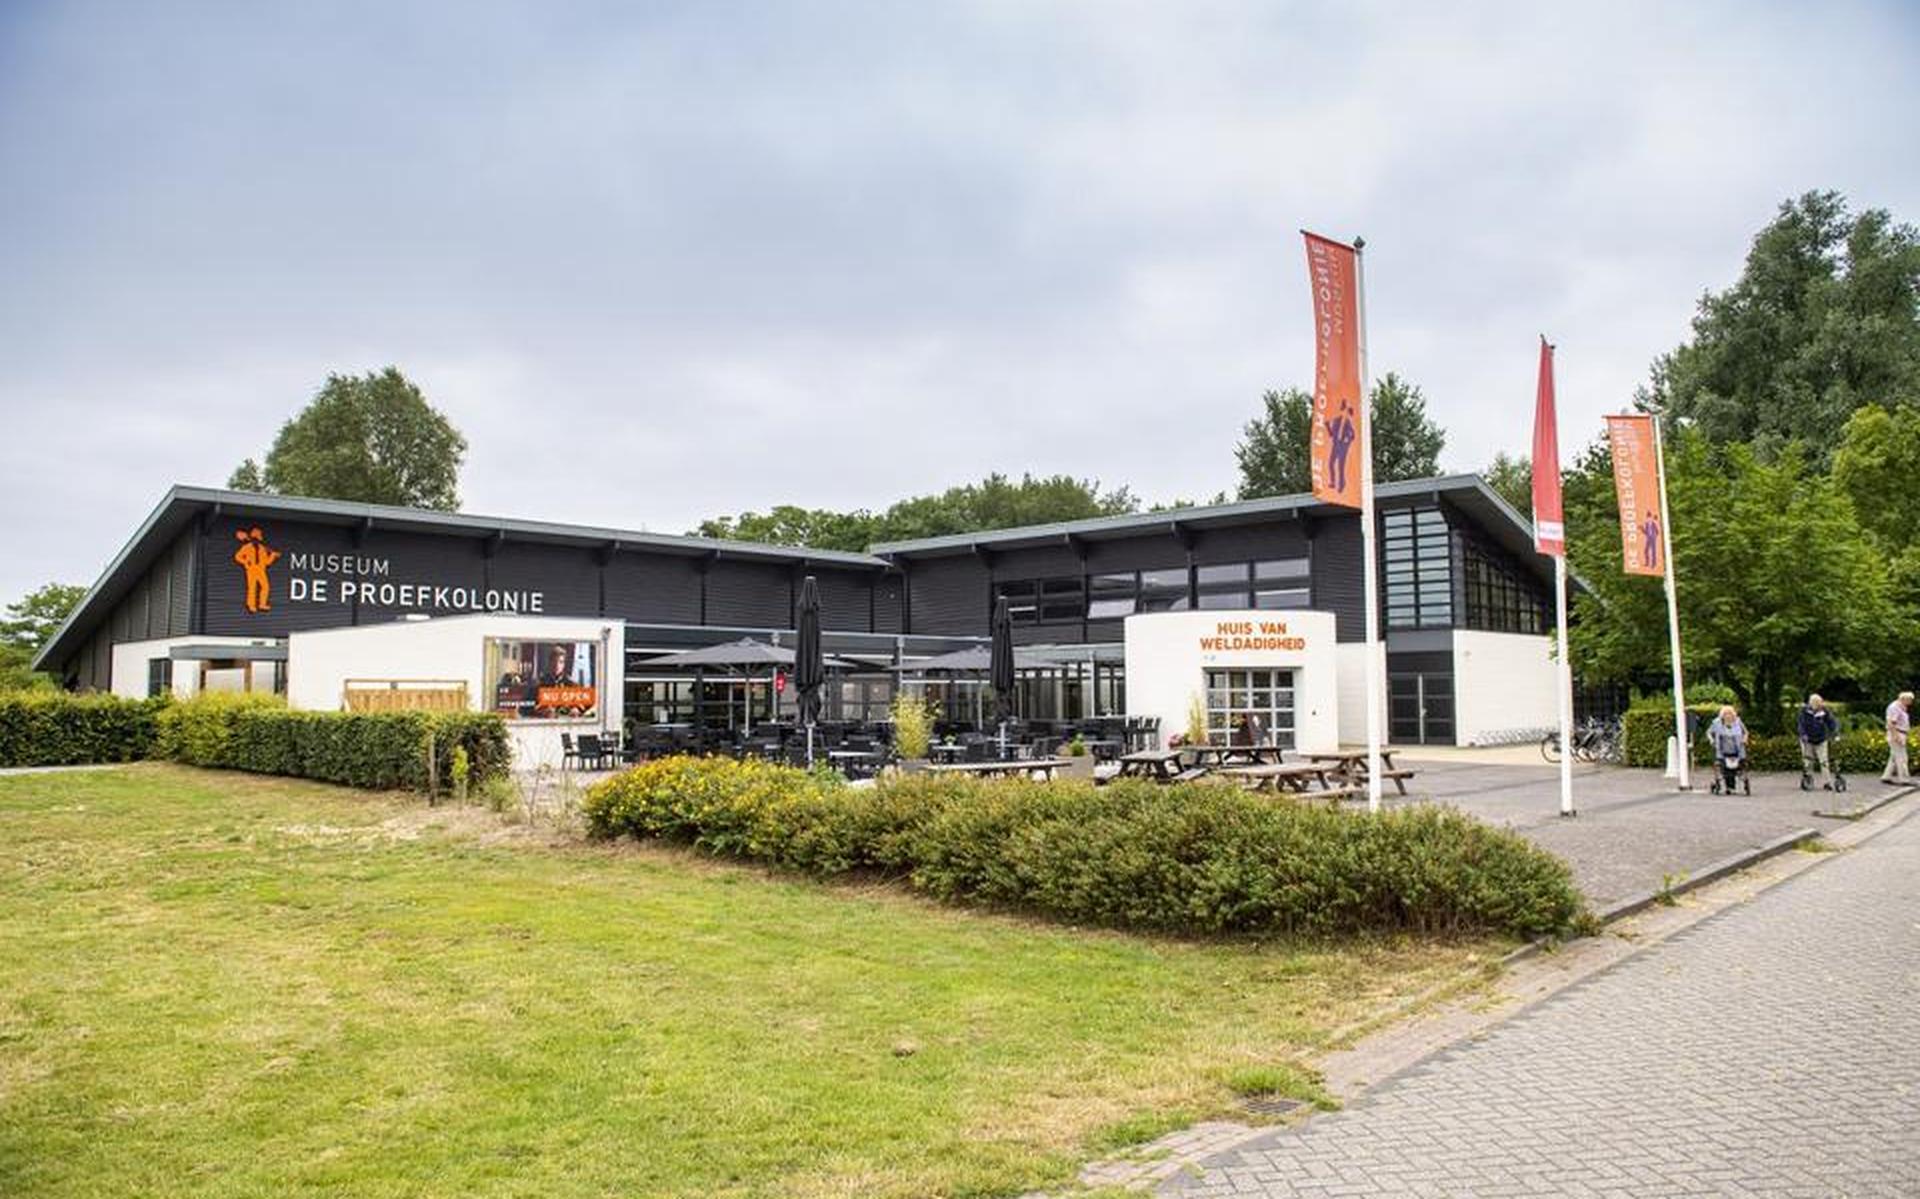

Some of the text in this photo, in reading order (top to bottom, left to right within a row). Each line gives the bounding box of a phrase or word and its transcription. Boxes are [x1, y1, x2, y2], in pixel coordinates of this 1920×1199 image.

[290, 553, 389, 576] MUSEUM
[290, 578, 544, 613] DE PROEFKOLONIE
[1217, 622, 1287, 635] HUIS VAN
[1200, 638, 1305, 650] WELDADIGHEID
